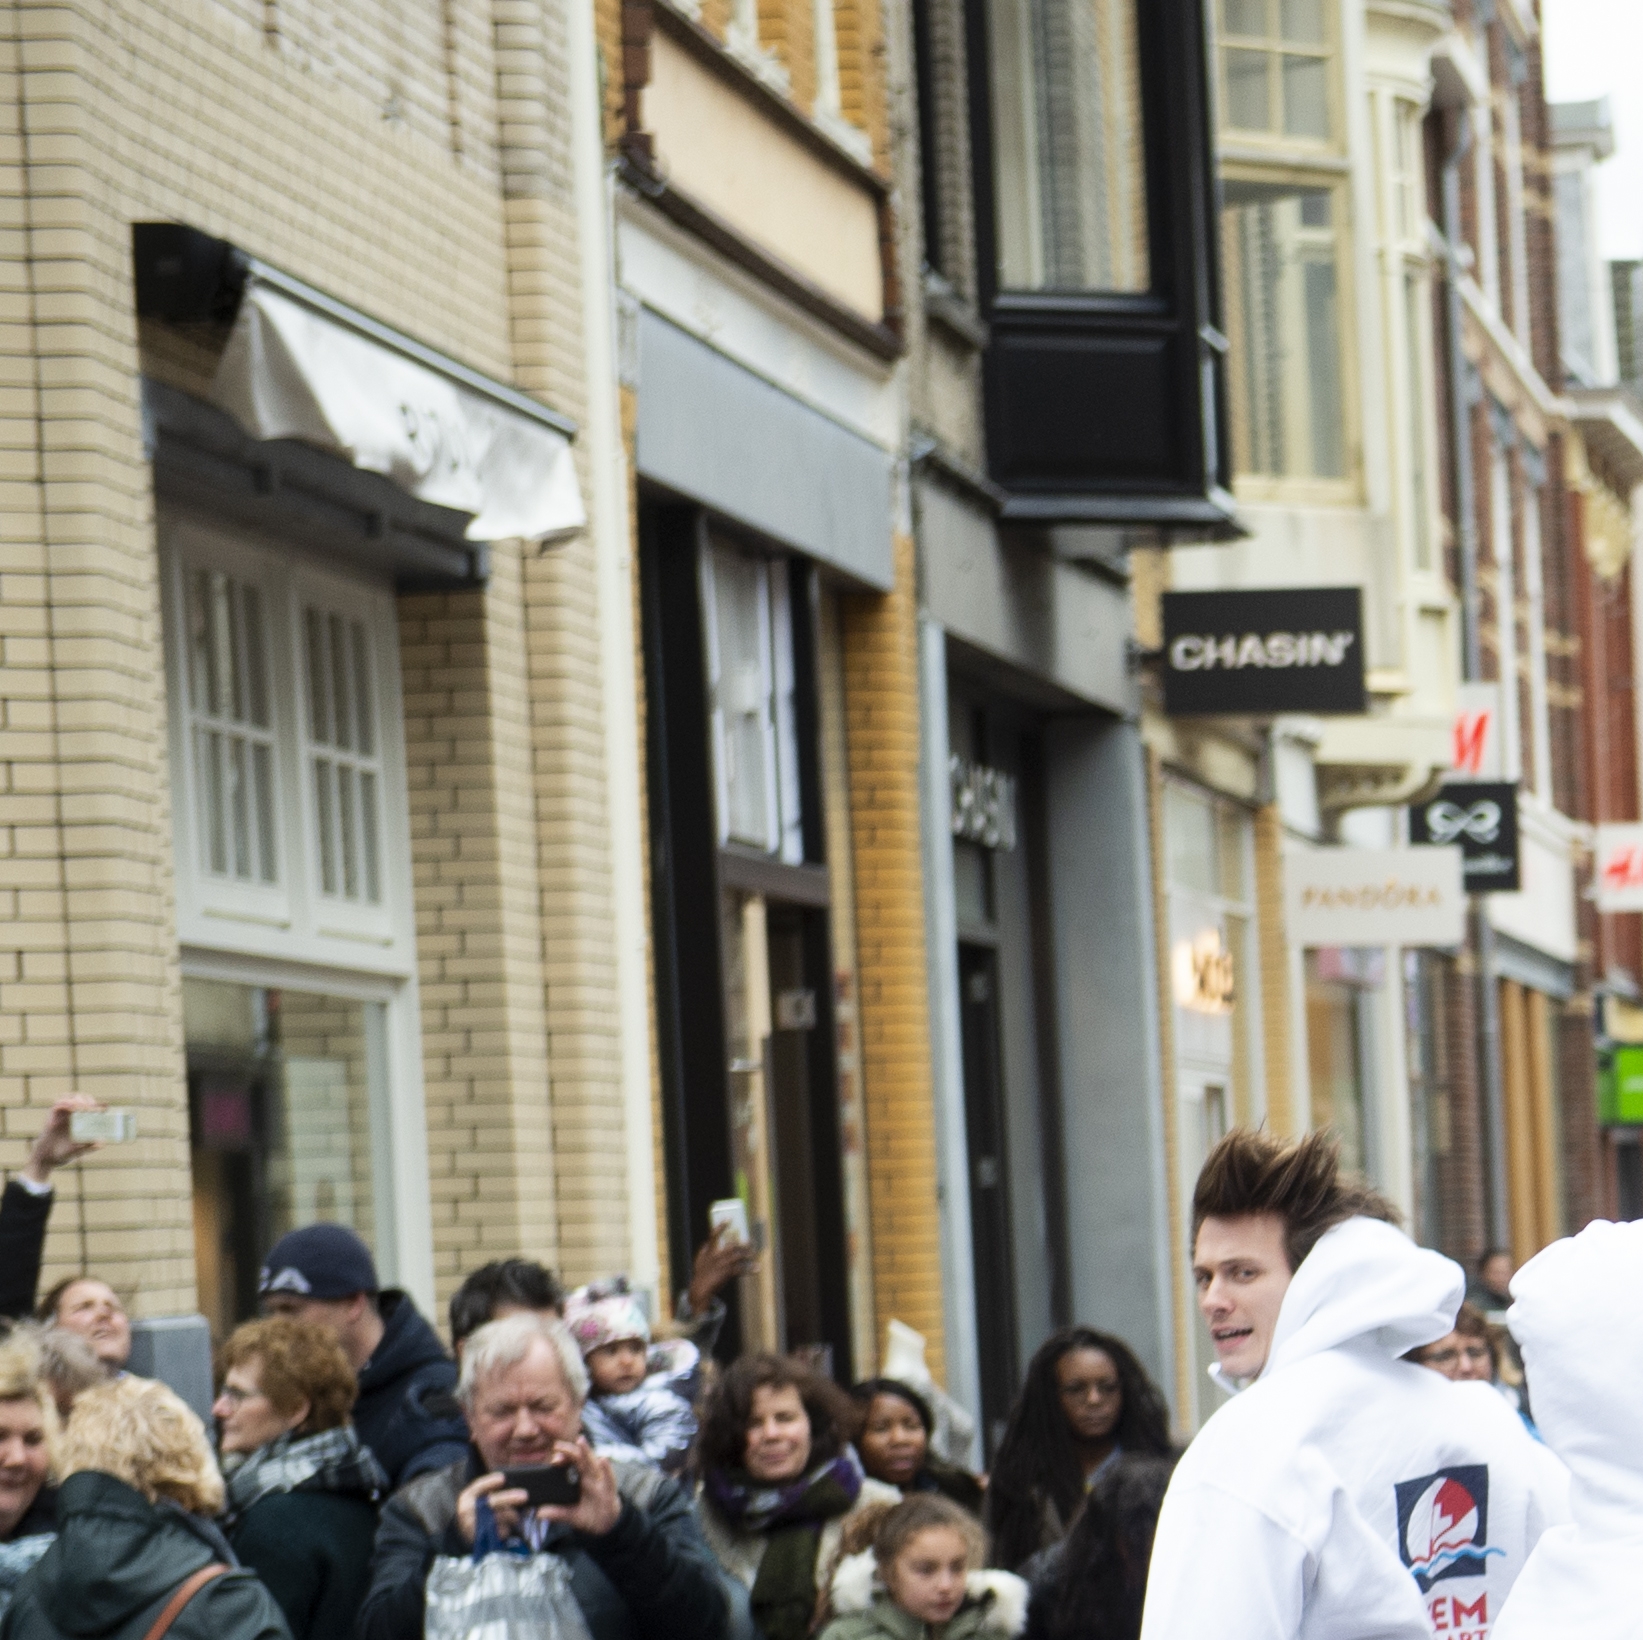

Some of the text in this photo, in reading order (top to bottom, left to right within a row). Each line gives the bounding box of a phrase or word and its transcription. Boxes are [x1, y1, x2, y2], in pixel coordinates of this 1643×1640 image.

[1170, 631, 1354, 671] CHASIN'
[1302, 881, 1442, 910] PANDORA
[1428, 1591, 1488, 1631] EM
